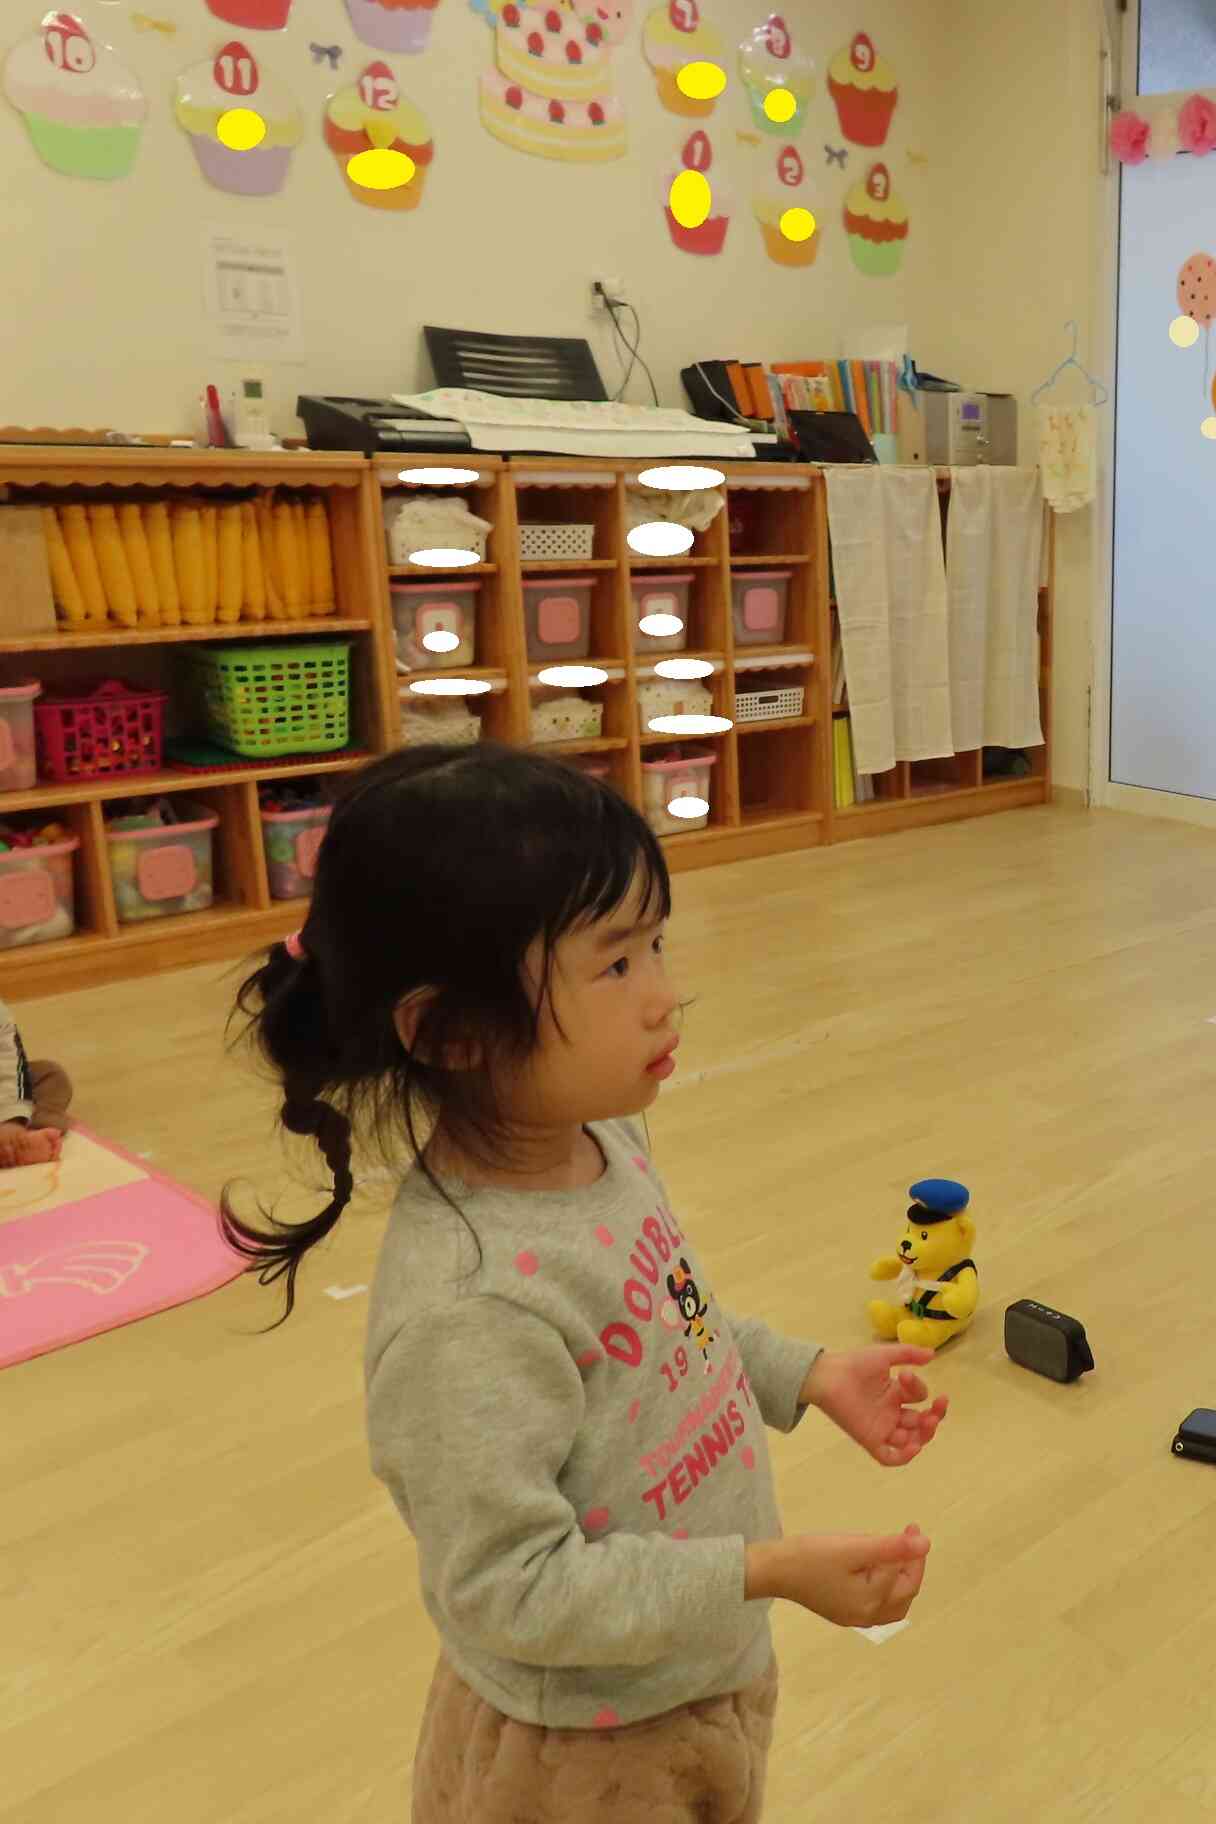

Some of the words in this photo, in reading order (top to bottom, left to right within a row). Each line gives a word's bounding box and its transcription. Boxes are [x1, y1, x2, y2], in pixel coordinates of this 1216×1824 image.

[47, 29, 95, 72] 10
[855, 44, 869, 70] 9
[218, 55, 253, 90] 11
[362, 75, 399, 110] 12
[783, 156, 798, 183] 2
[872, 173, 886, 198] 3
[601, 1204, 684, 1368] DOUBL
[640, 1400, 745, 1521] TENNIS
